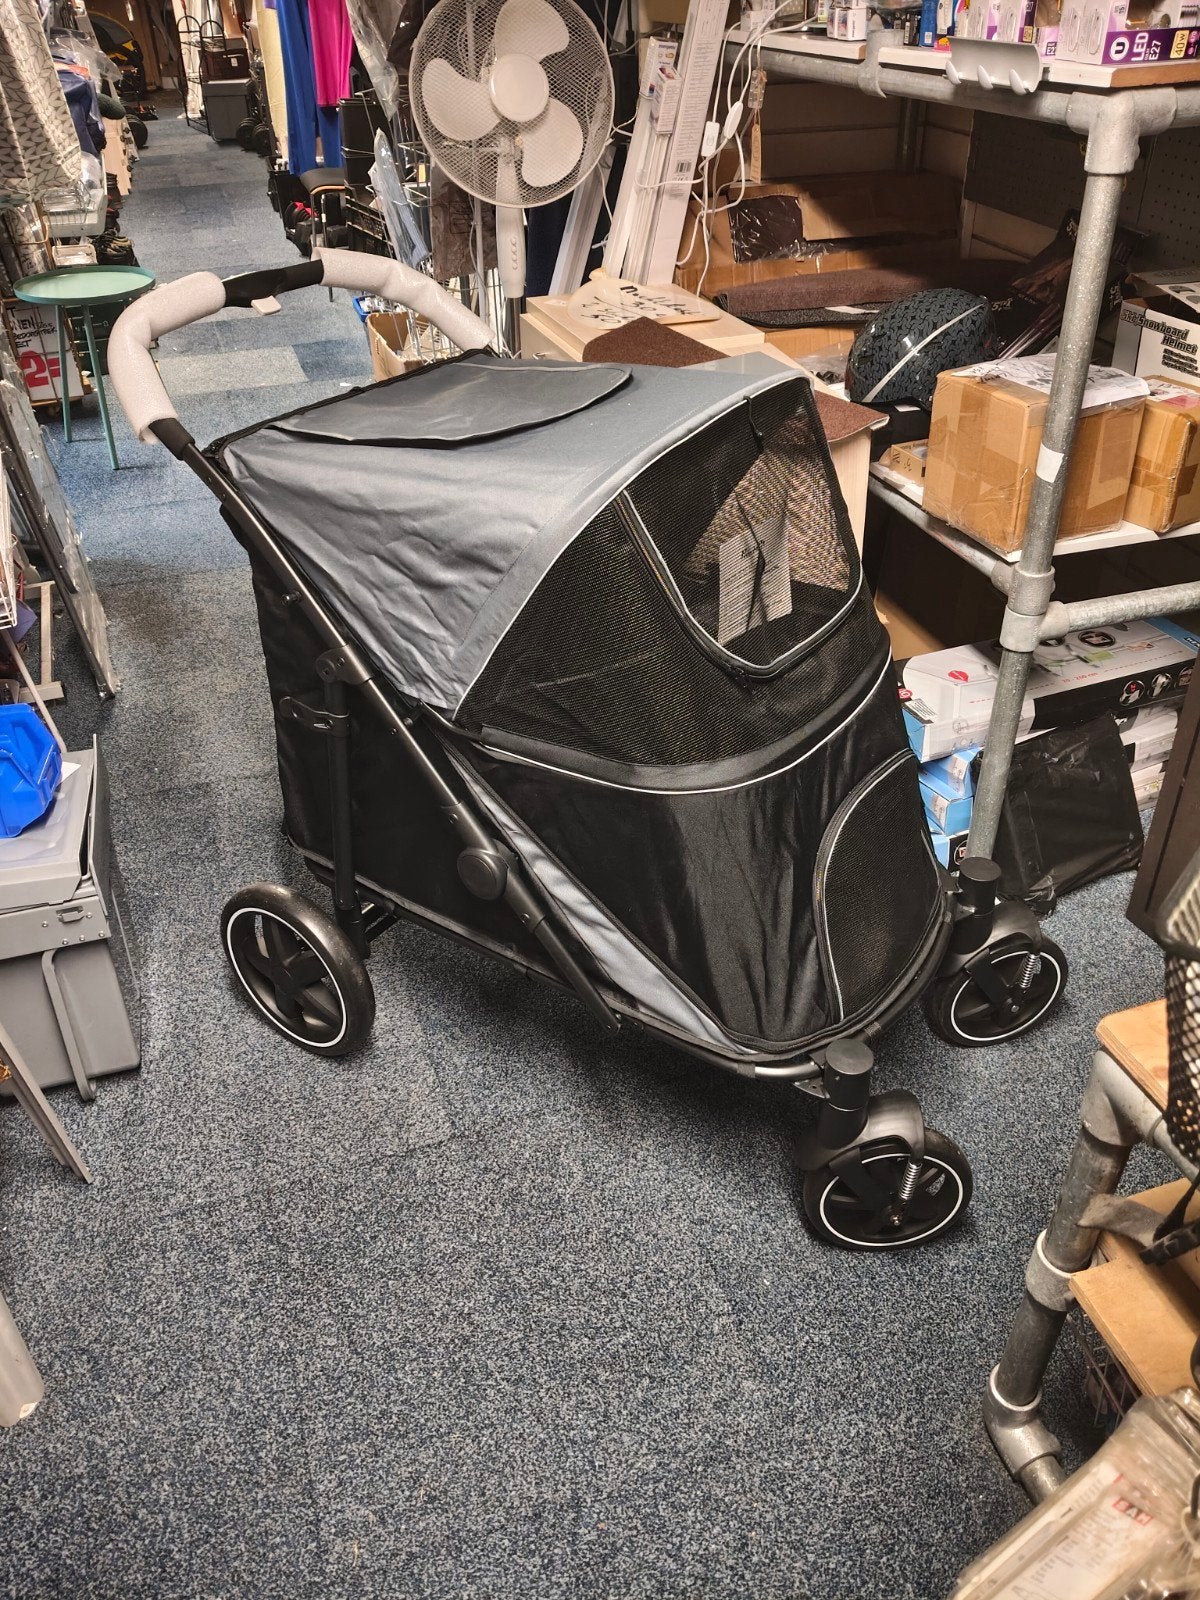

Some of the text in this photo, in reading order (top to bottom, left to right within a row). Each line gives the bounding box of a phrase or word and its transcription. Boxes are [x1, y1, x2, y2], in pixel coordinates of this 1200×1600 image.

[1131, 32, 1149, 61] LED
[1149, 40, 1162, 60] E27
[1161, 334, 1198, 356] Helmet
